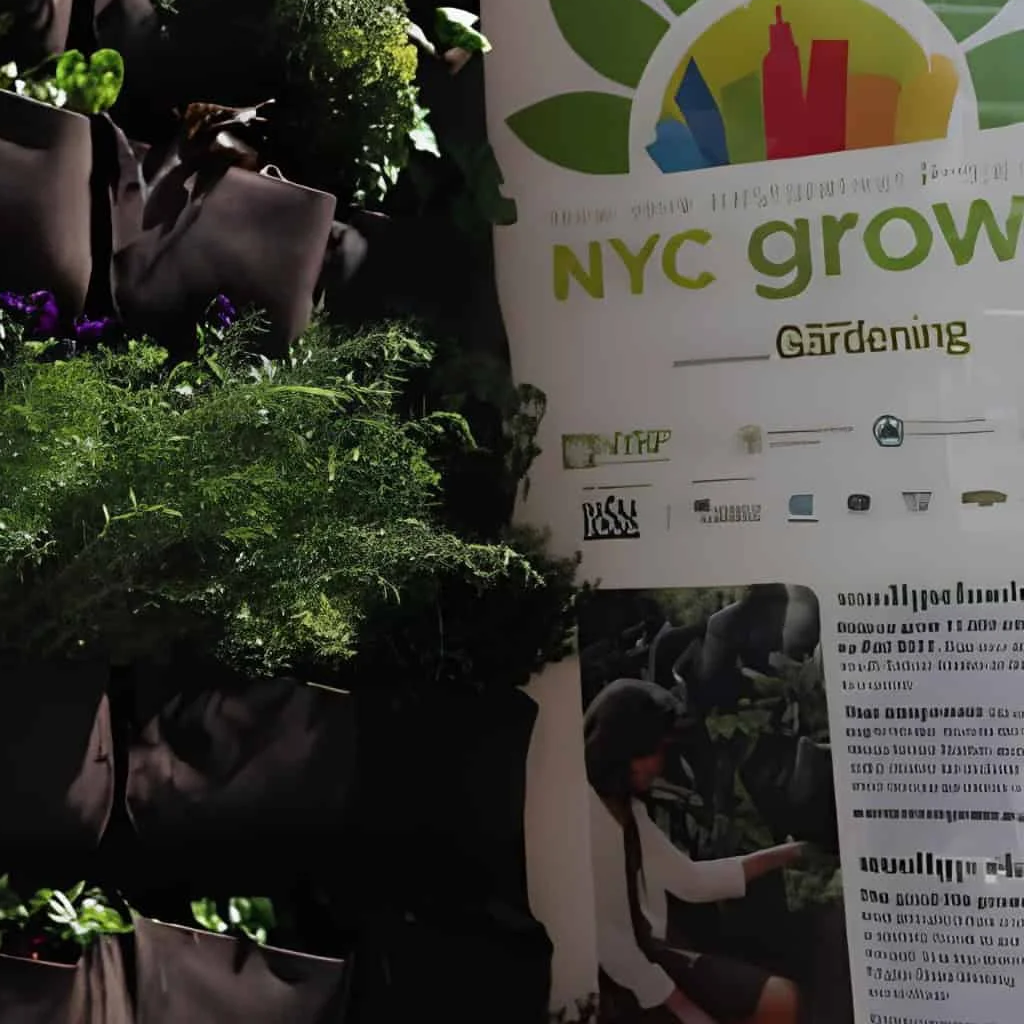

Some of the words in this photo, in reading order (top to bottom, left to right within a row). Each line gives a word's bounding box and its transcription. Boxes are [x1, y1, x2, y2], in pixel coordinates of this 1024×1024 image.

[553, 228, 717, 302] NYC
[747, 195, 1024, 300] grow
[776, 314, 971, 359] Gardening
